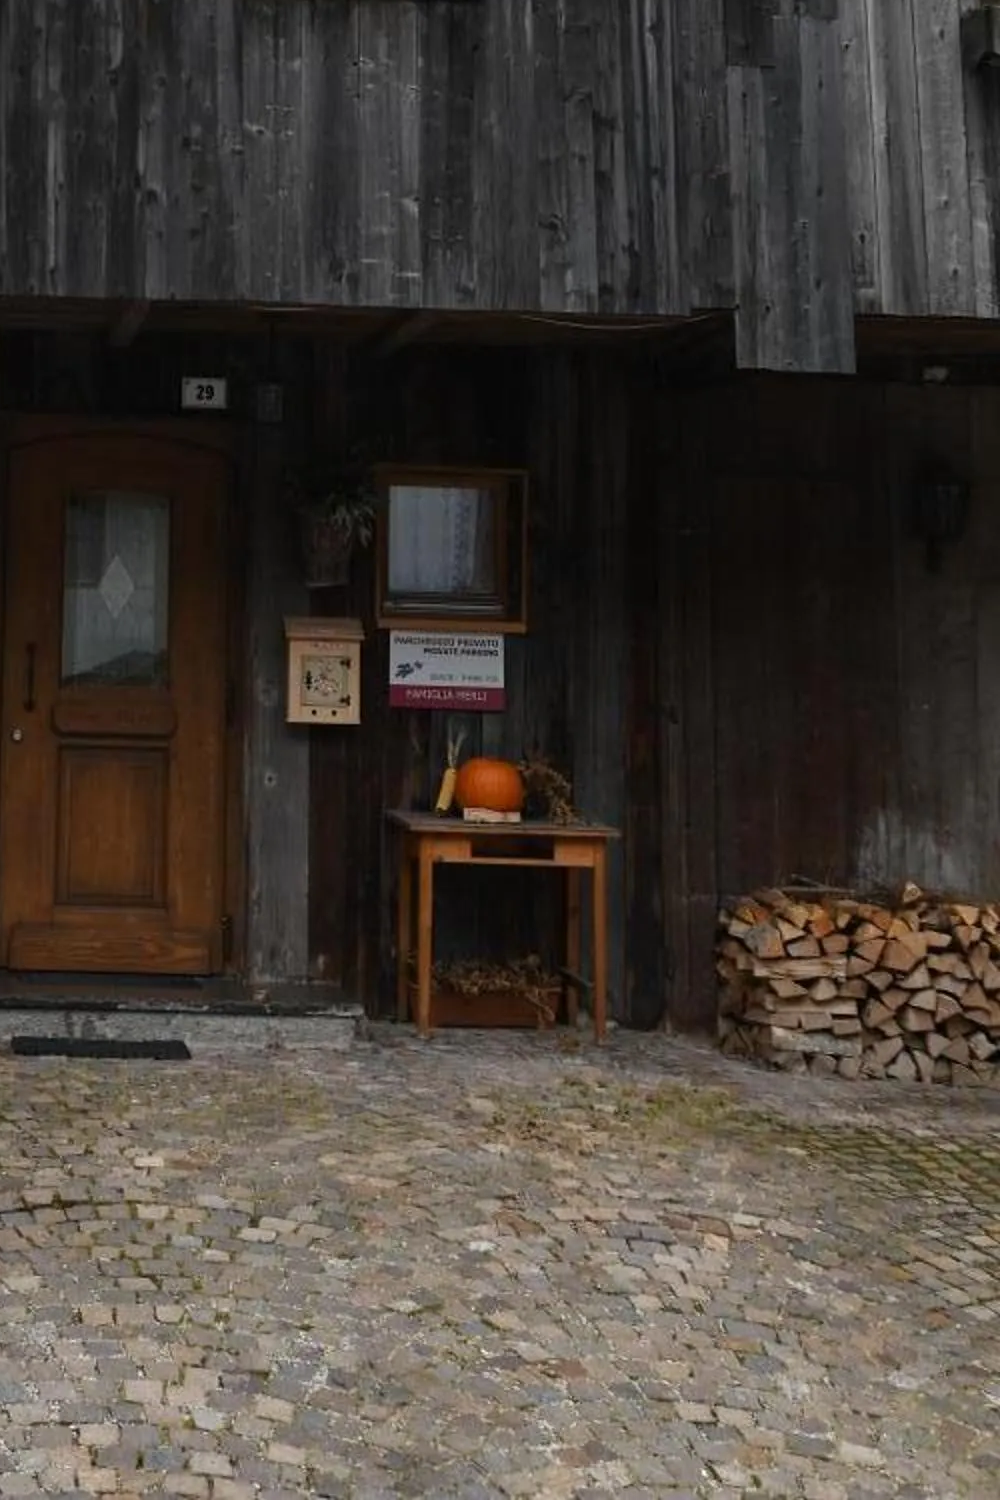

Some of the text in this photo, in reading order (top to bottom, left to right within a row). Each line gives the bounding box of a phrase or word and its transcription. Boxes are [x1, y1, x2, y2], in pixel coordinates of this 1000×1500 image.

[196, 384, 214, 401] 29
[457, 638, 499, 648] PRIVATO
[405, 688, 453, 700] FAMIGLIA
